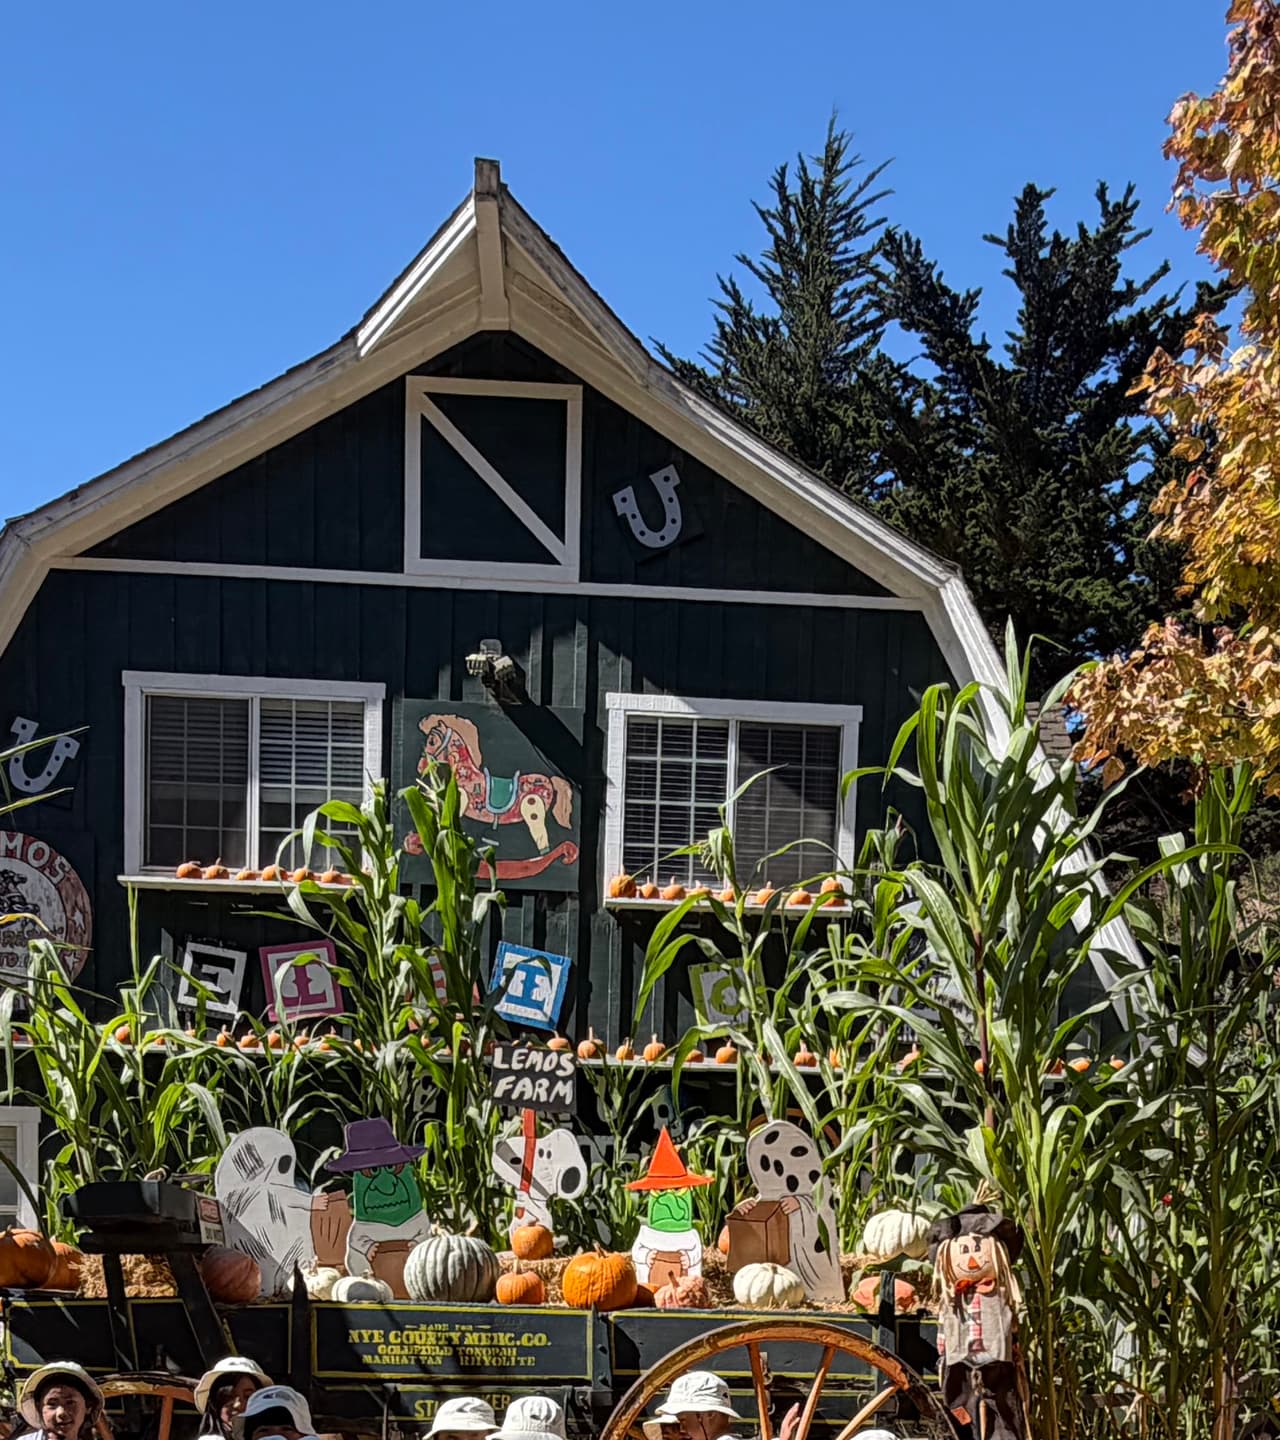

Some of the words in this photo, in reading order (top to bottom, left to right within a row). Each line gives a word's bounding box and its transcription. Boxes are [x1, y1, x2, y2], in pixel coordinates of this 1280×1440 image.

[493, 1047, 575, 1077] LEMOS
[493, 1075, 573, 1105] FARM
[348, 1330, 384, 1343] NYE
[389, 1330, 460, 1345] COUNTY
[377, 1344, 453, 1356] GOLDFIELD
[457, 1346, 517, 1357] TONOPAH
[362, 1355, 442, 1365] MANHATTAN
